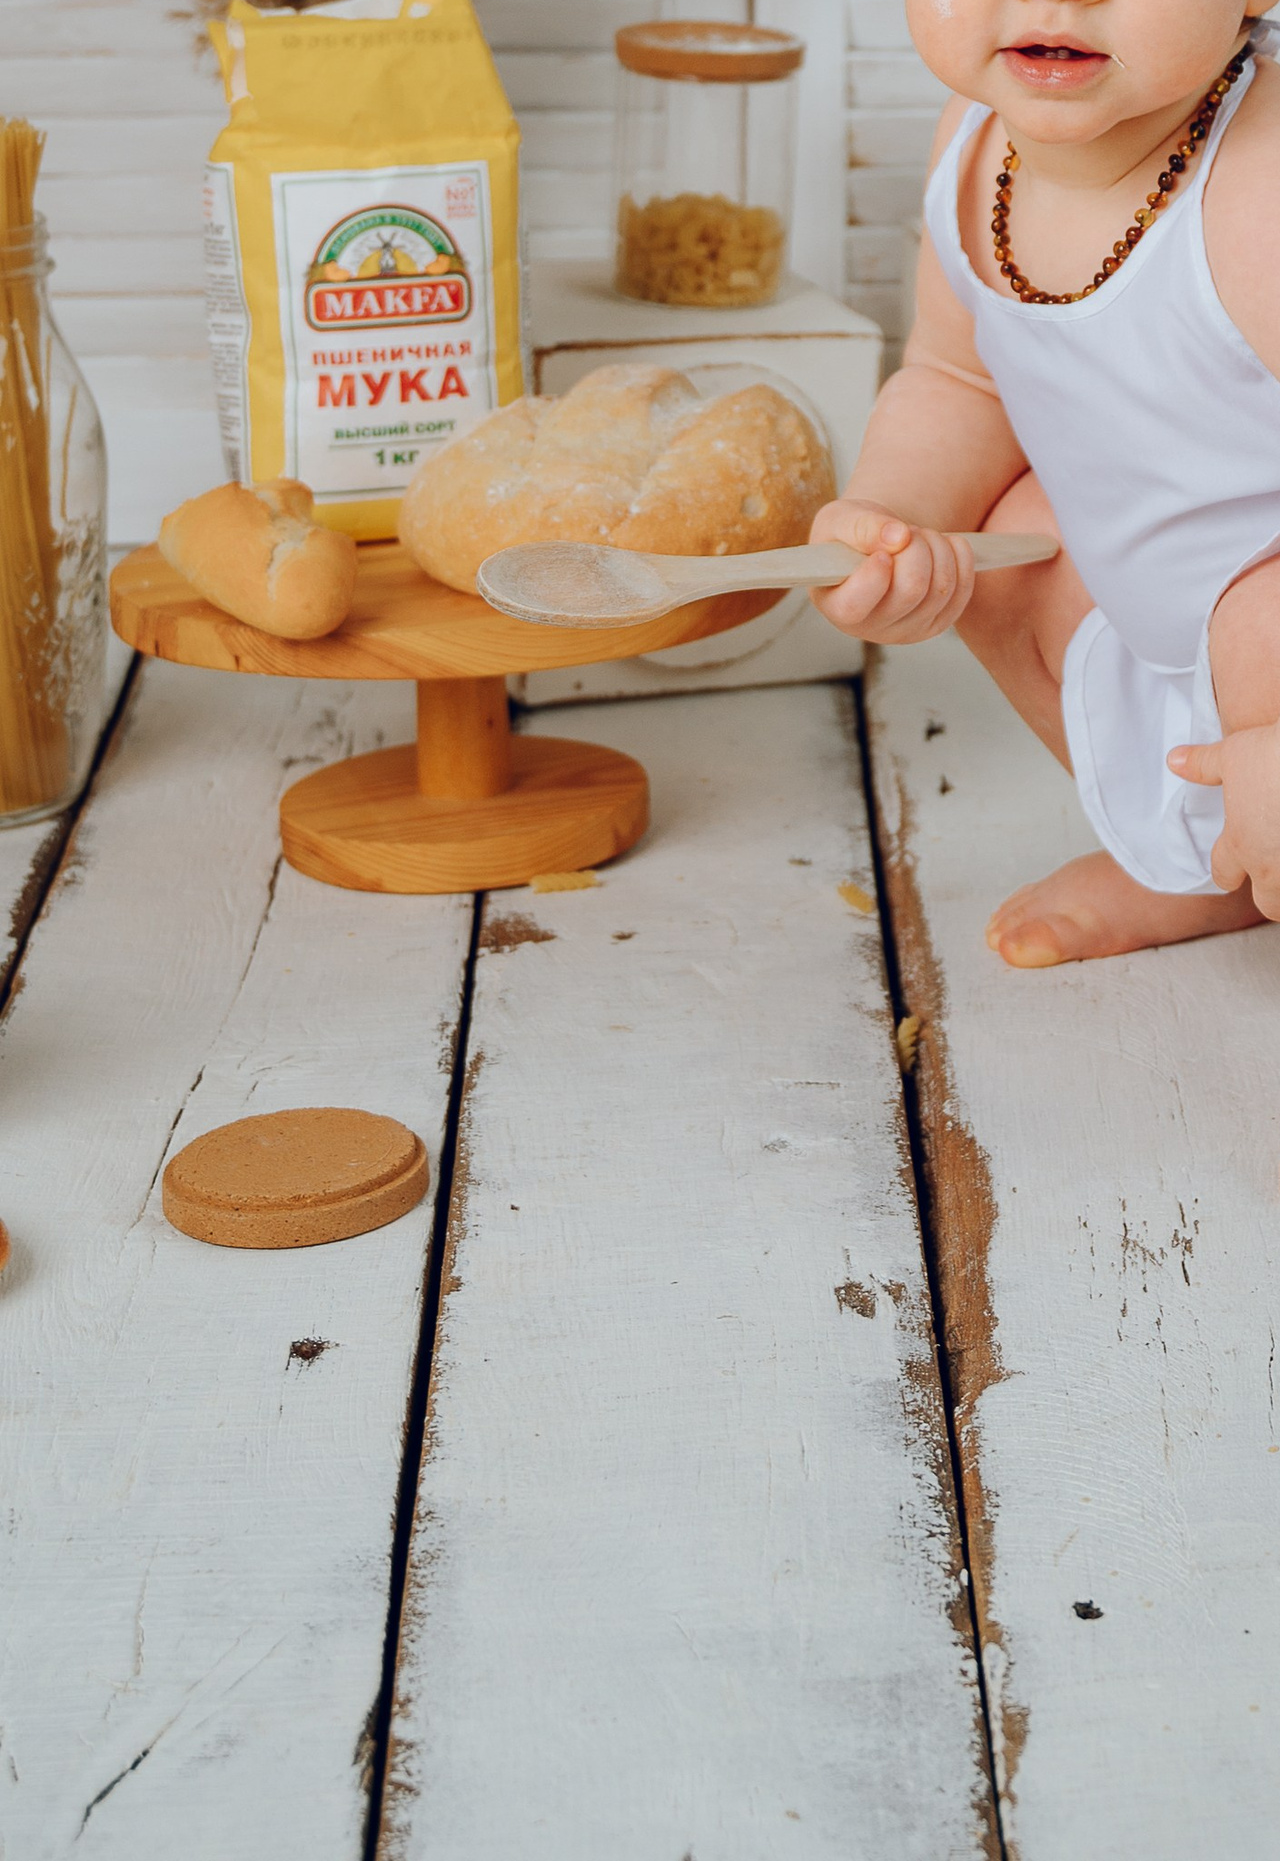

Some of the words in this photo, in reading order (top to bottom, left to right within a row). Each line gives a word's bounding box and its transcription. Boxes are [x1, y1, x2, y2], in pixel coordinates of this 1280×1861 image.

[324, 285, 454, 318] MAKFA
[312, 341, 472, 366] ПШЕНИЧНАЯ
[317, 366, 469, 407] МУКА
[334, 422, 410, 439] ВЫСШИЙ
[415, 419, 456, 434] СОРТ
[375, 449, 386, 466] 1
